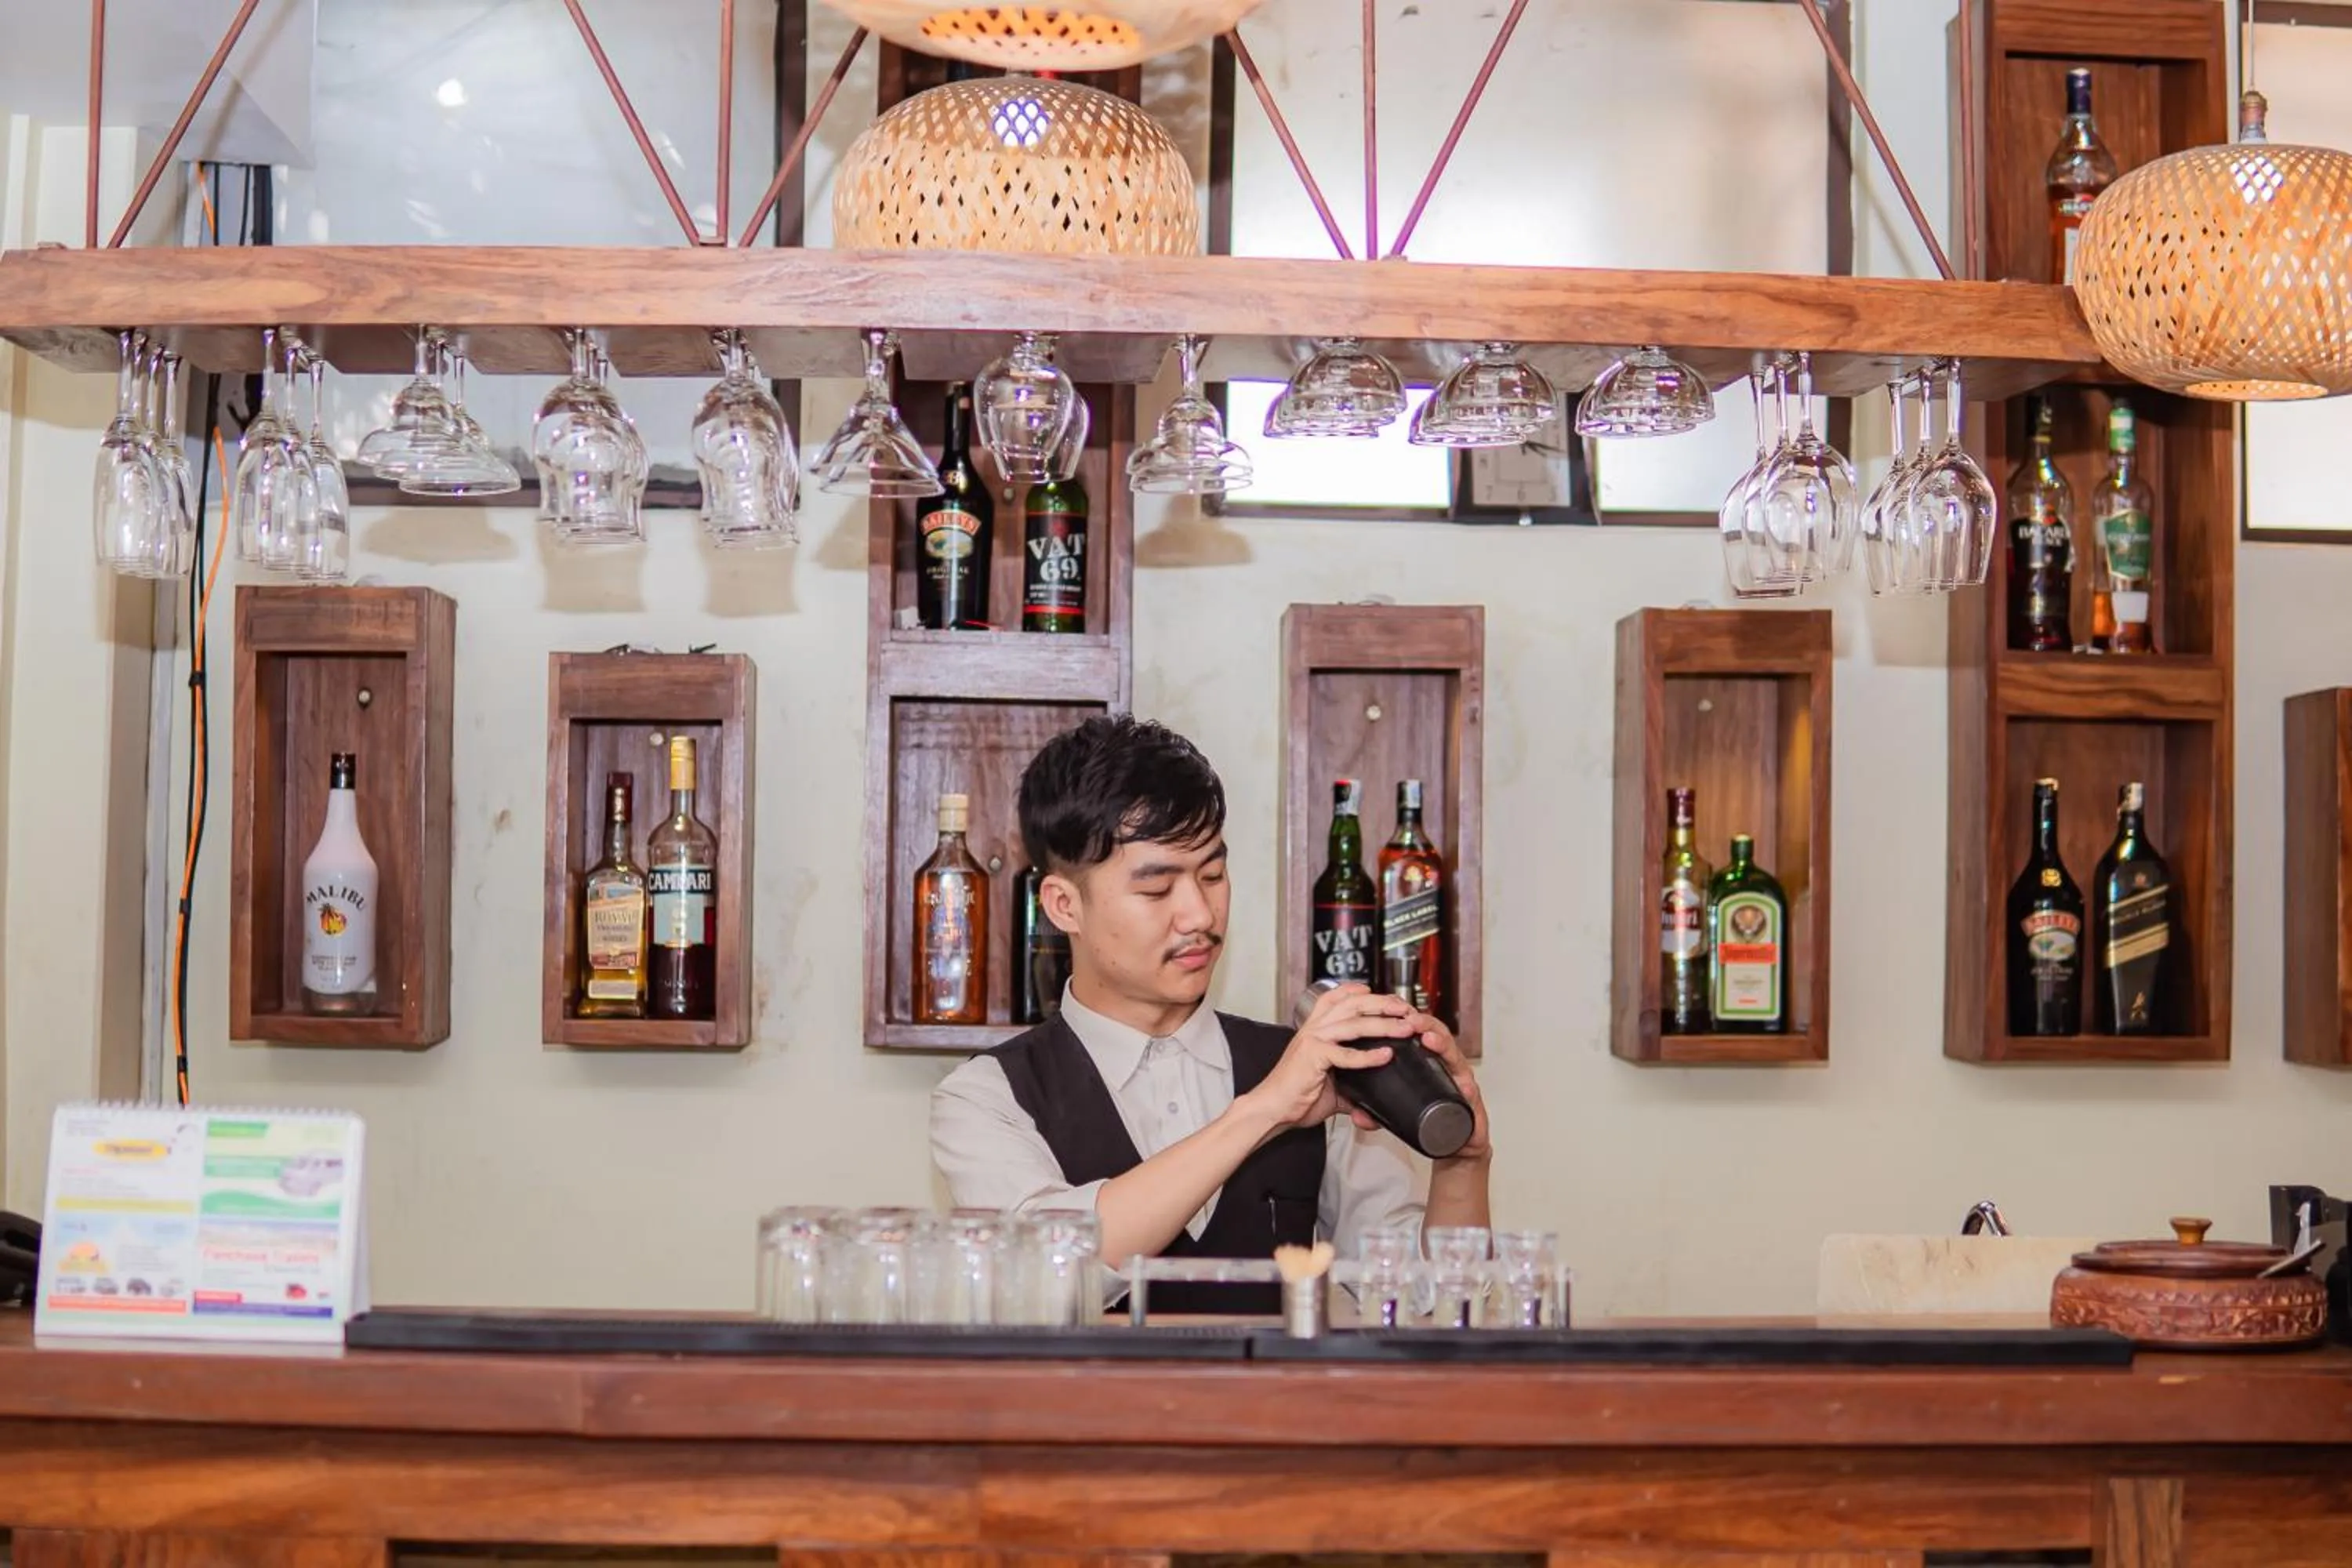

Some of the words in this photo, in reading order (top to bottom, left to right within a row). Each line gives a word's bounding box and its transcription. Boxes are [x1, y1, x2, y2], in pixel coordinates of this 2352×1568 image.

[1027, 534, 1085, 560] VAT
[307, 885, 365, 911] MALIBU
[1315, 925, 1373, 953] VAT
